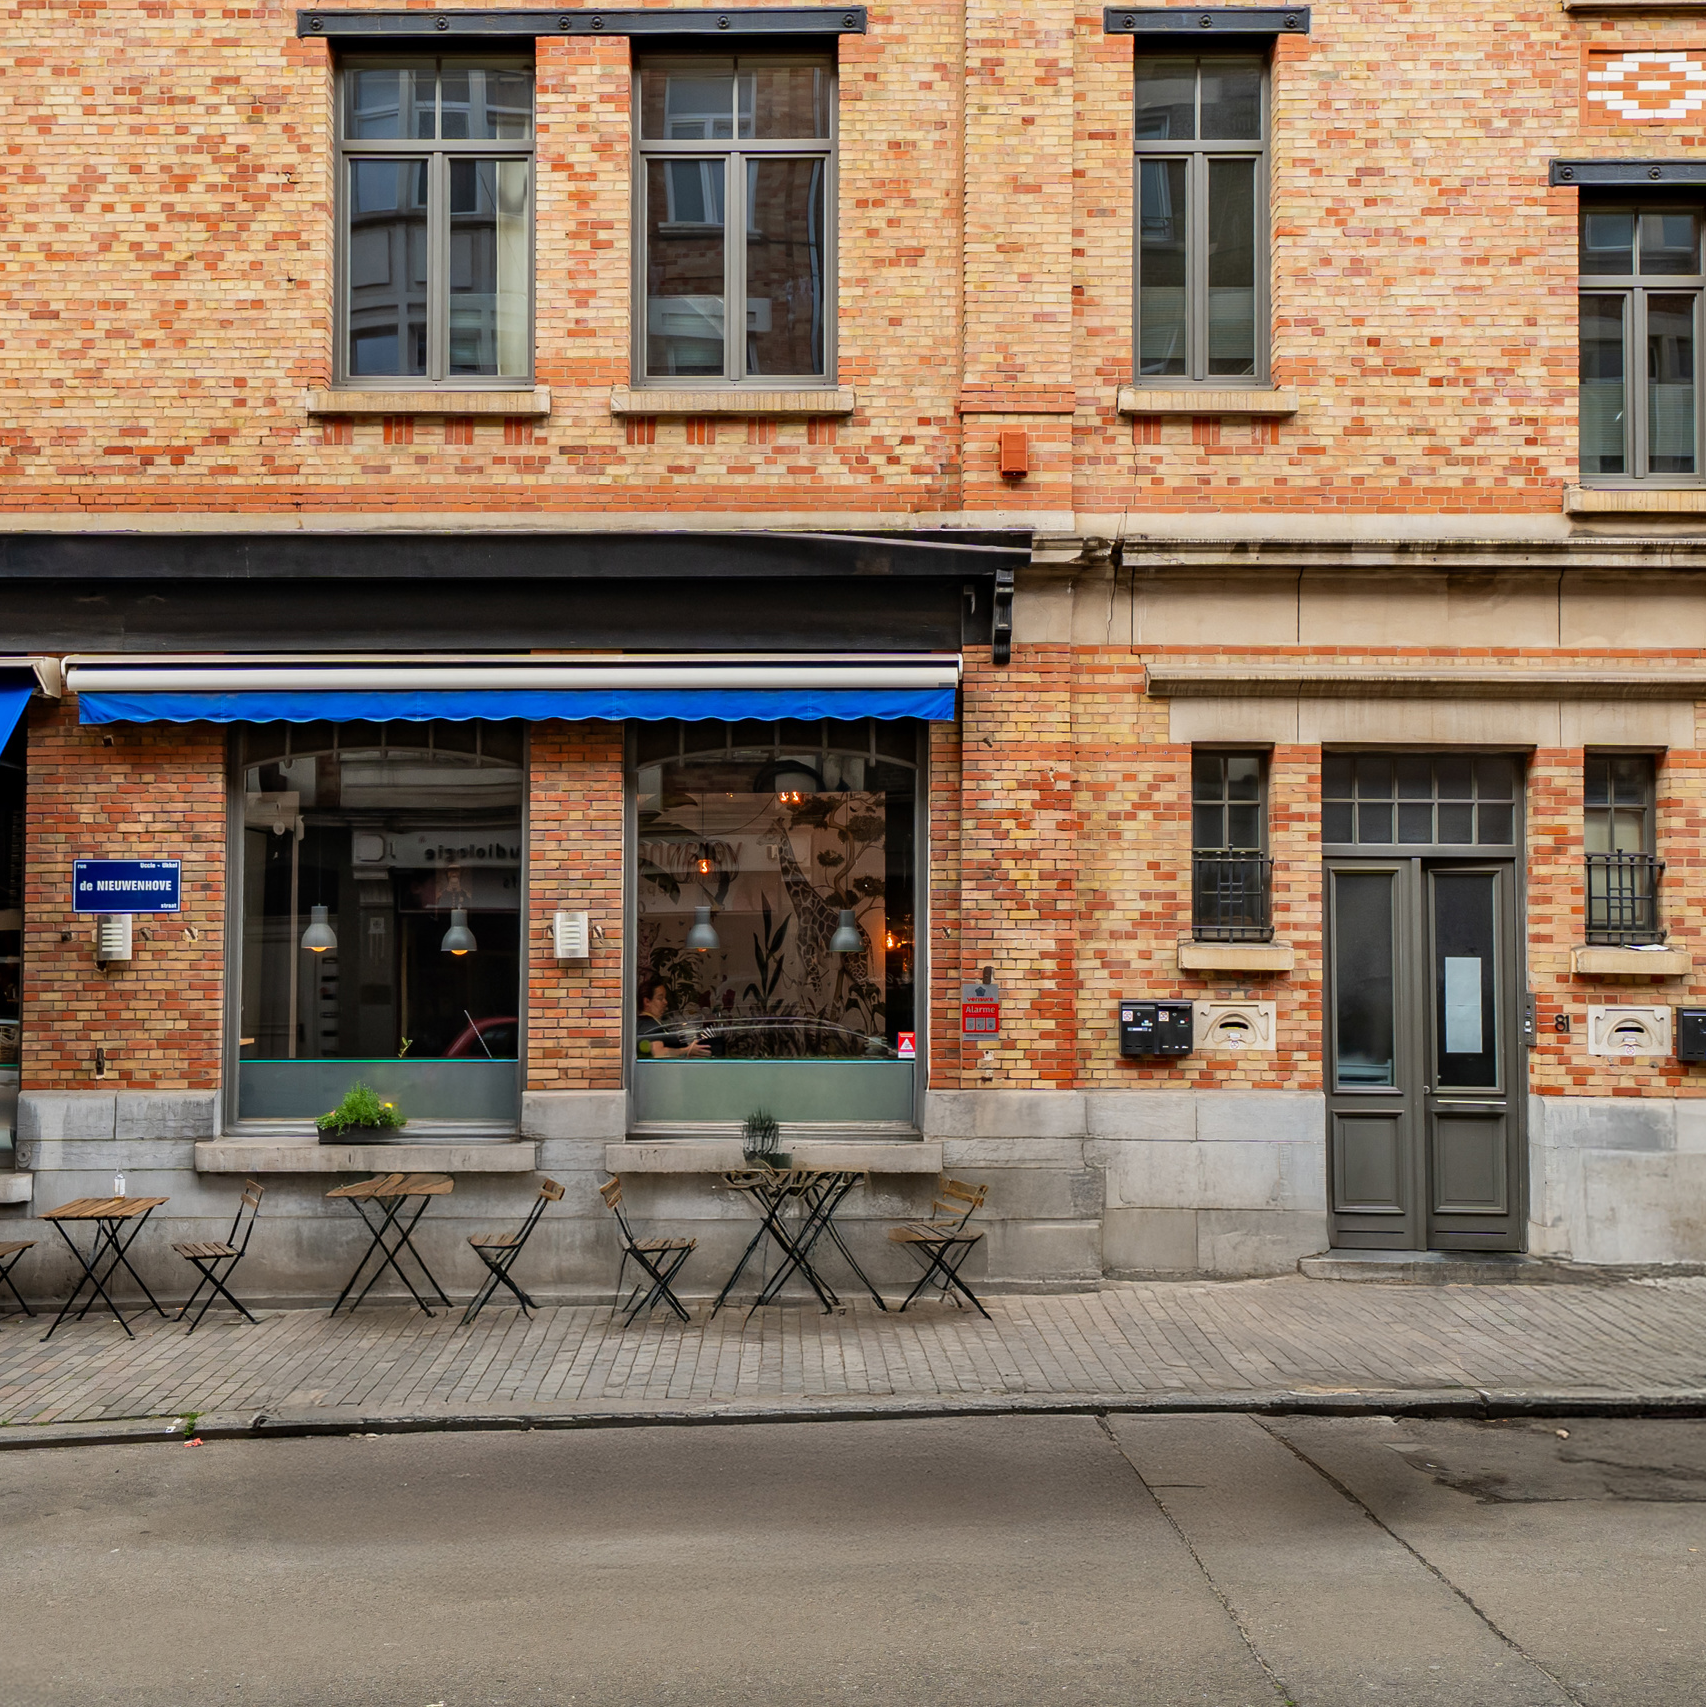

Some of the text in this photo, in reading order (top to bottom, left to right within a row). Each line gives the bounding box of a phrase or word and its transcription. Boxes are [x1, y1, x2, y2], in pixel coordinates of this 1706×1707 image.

[79, 880, 172, 891] de NIEUWENHOVE
[965, 1005, 996, 1014] Alarme
[1554, 1014, 1571, 1032] 81
